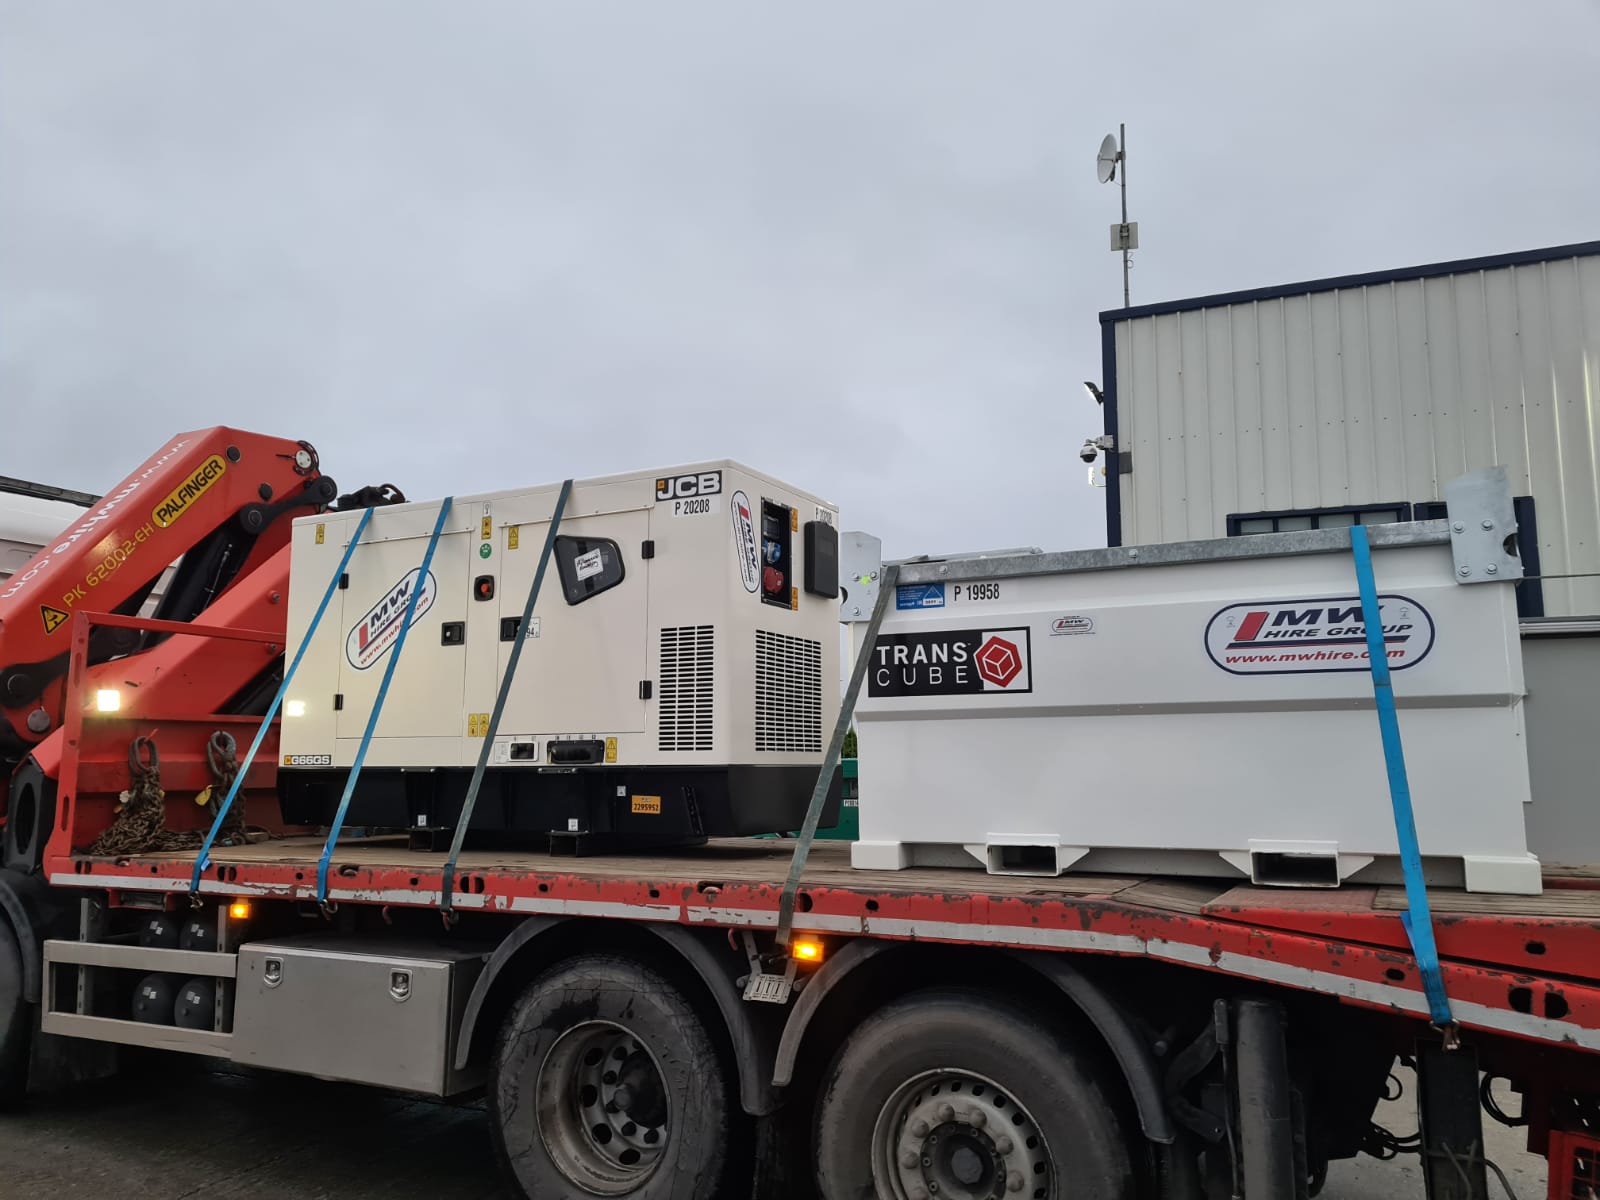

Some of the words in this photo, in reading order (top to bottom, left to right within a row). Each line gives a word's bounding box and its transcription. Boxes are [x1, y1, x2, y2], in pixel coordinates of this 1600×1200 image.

[156, 459, 223, 523] PALFINGER
[657, 472, 720, 500] JCB
[674, 501, 681, 516] P
[683, 498, 710, 515] 20208
[62, 583, 87, 608] PK
[85, 522, 155, 587] 62002-EH
[370, 579, 410, 628] MW
[953, 585, 962, 602] P
[966, 583, 1000, 601] 19958
[370, 614, 391, 638] HIRE
[1271, 605, 1384, 627] MW
[1263, 627, 1320, 639] HIRE
[876, 641, 968, 666] TRANS
[1225, 649, 1405, 664] www.mwhire.cm
[876, 665, 969, 687] CUBE
